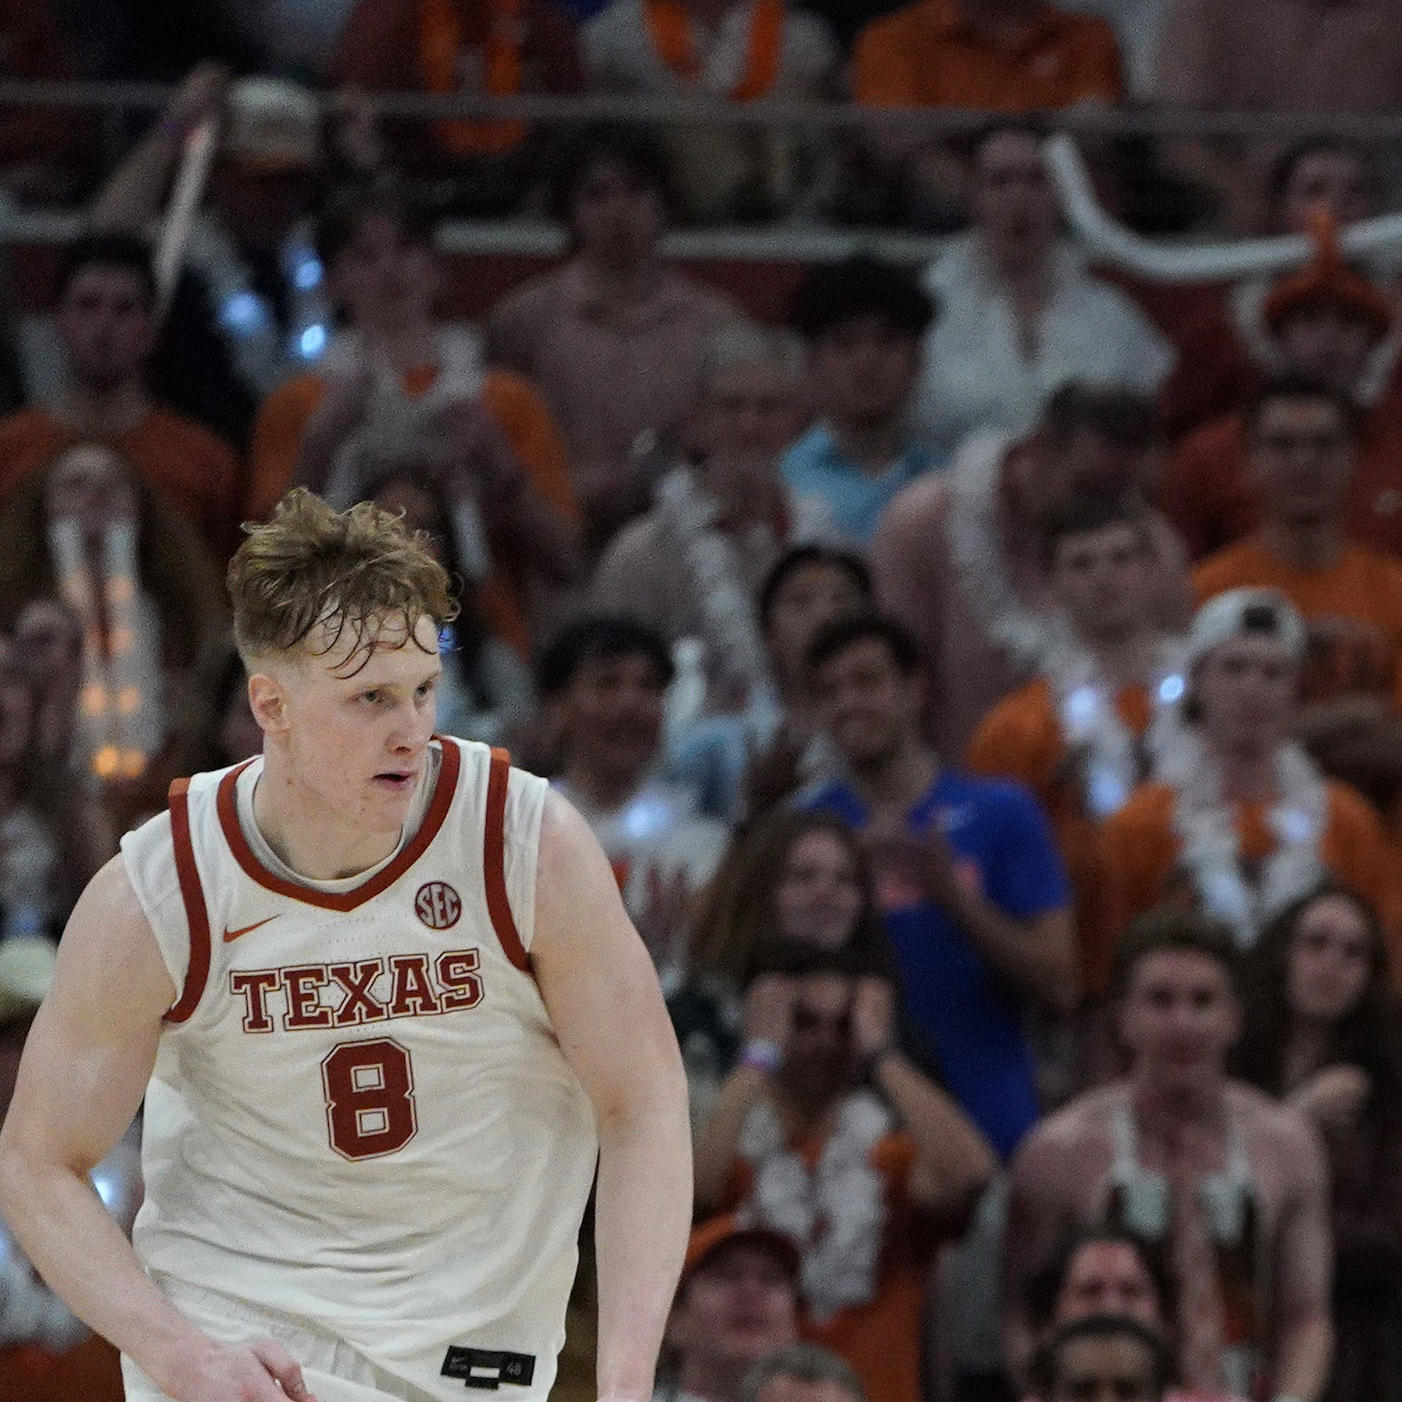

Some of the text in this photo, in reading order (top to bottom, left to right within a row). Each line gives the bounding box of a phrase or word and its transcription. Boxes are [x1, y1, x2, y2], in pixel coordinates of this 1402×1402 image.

[416, 882, 461, 929] SEC
[229, 948, 485, 1034] TEXAS
[321, 1036, 418, 1162] 8
